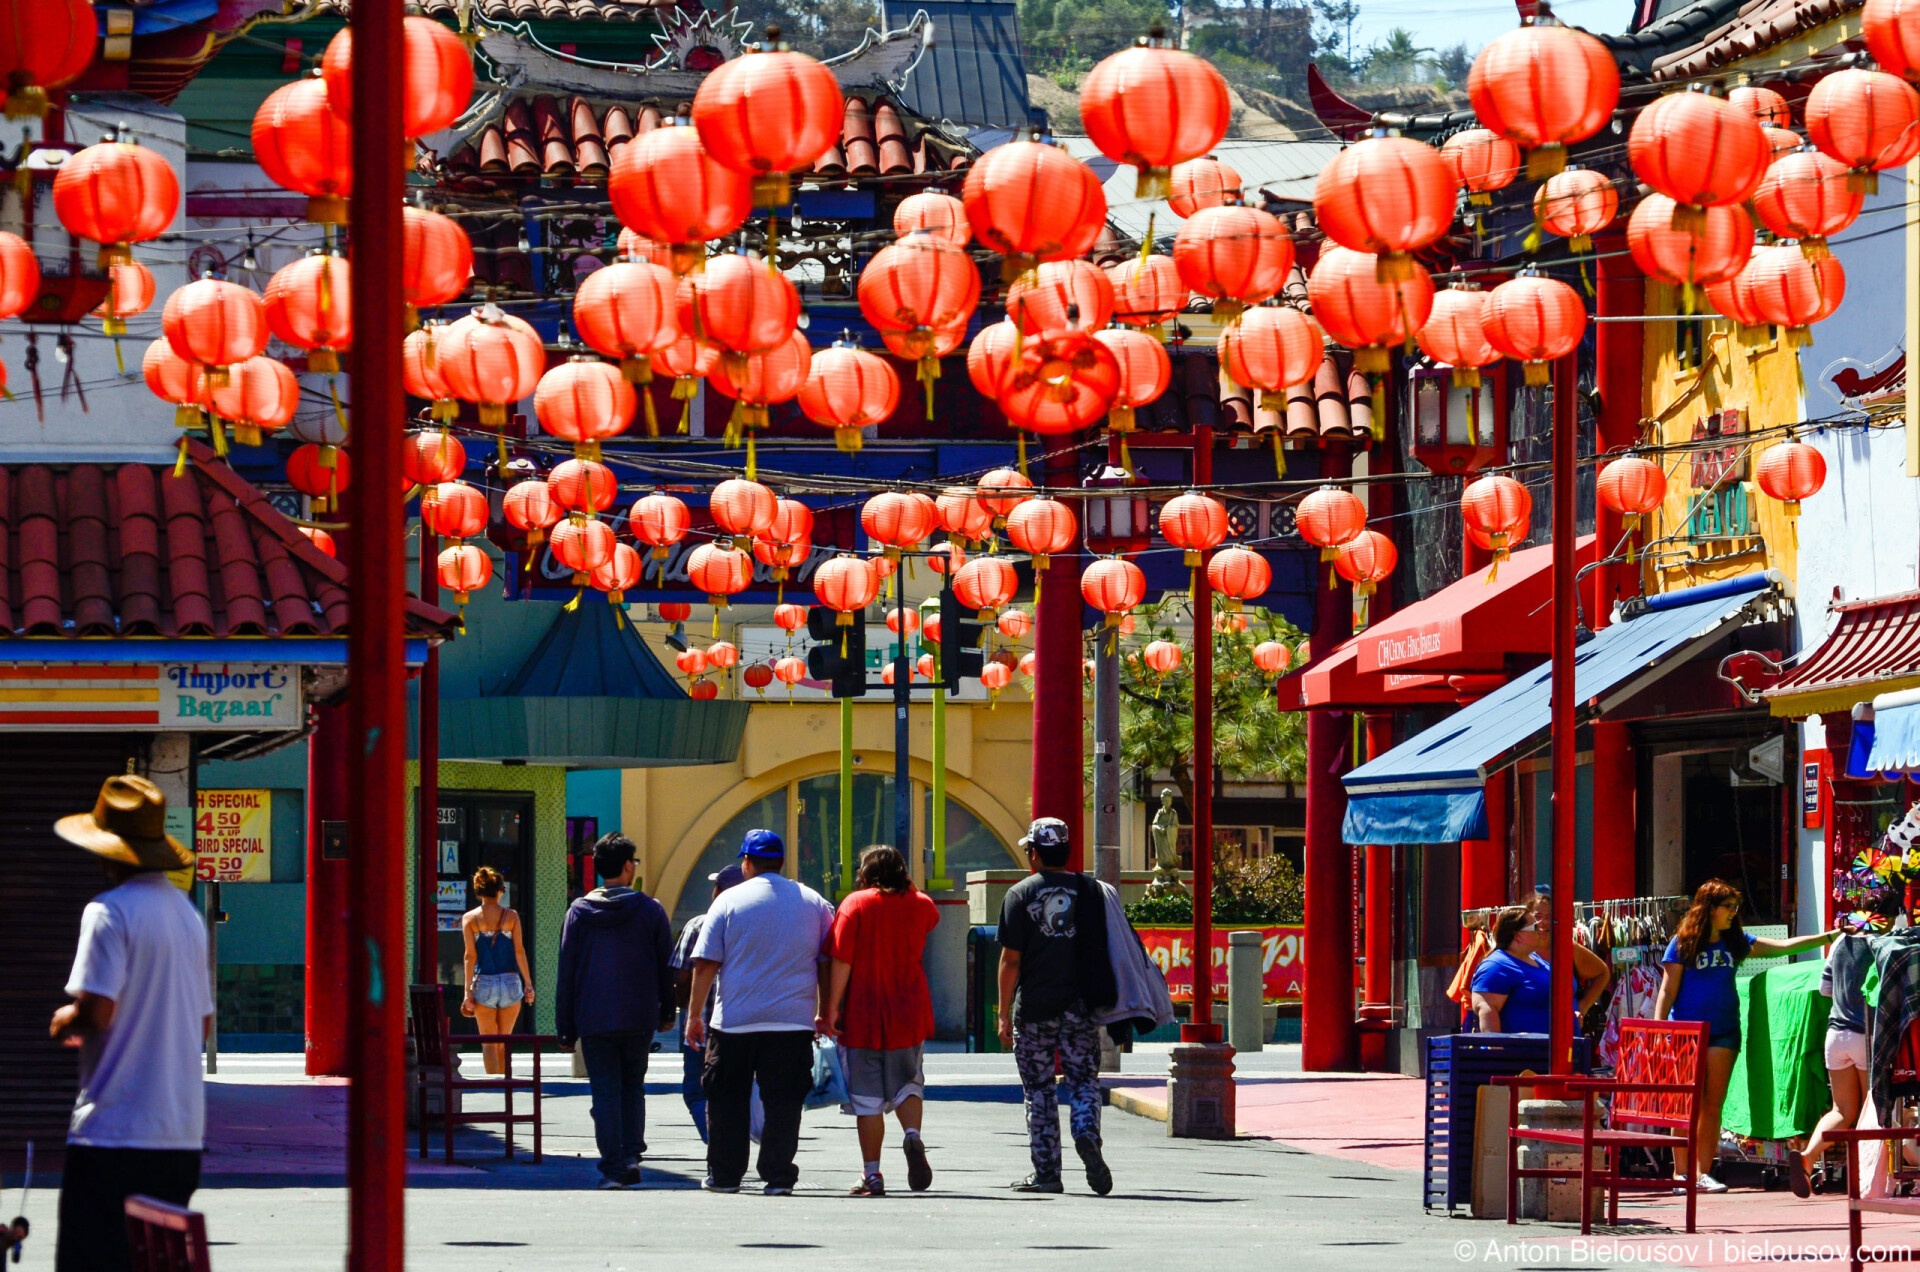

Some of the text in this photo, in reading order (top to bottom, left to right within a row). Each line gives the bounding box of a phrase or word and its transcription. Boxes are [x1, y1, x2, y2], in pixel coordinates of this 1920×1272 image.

[1390, 639, 1406, 661] CHONG
[168, 667, 287, 695] Import
[176, 693, 282, 723] Bazaar
[208, 794, 260, 808] SPECIAL
[196, 838, 264, 853] BIRD SPECIAL
[446, 846, 455, 863] A
